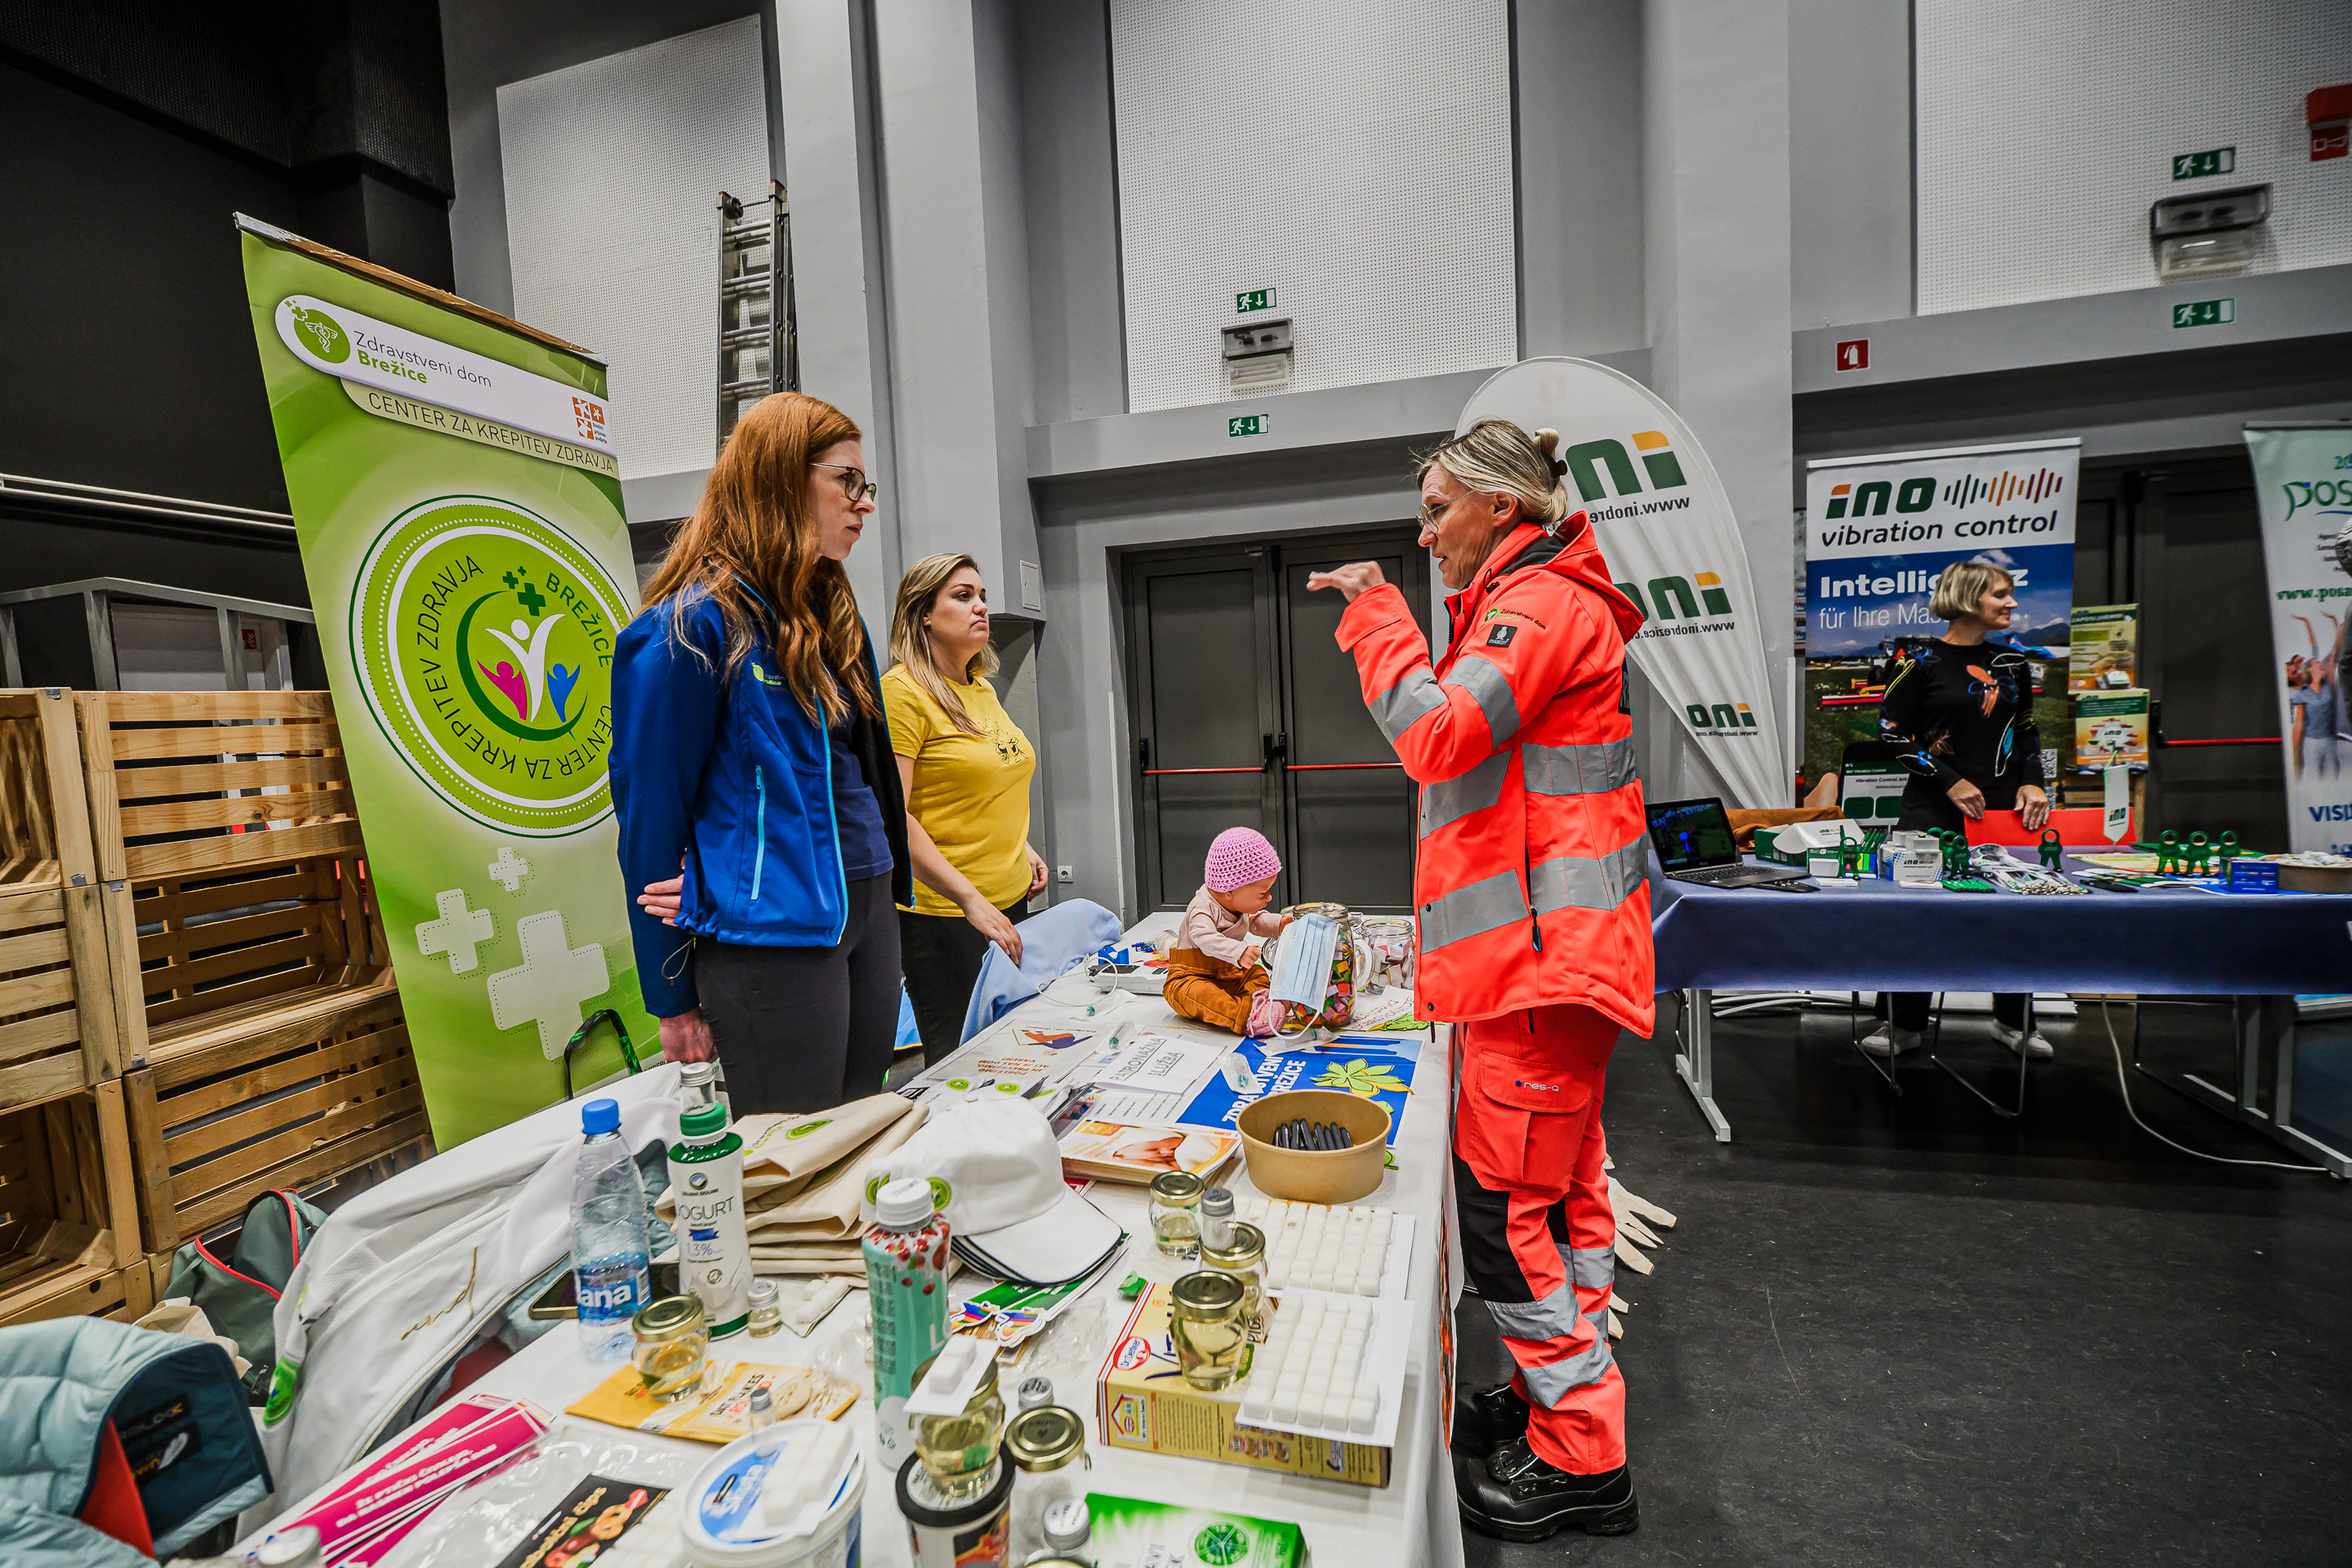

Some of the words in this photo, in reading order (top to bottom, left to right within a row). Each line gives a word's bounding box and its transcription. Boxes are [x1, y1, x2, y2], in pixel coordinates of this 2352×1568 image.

[354, 330, 453, 376] Zdravstveni
[457, 364, 492, 388] dom
[357, 350, 428, 385] Brežice
[368, 392, 445, 429] CENTER
[449, 414, 474, 436] ZA
[477, 422, 552, 457] KREPITEV
[555, 444, 614, 474] ZDRAVJA
[1825, 476, 1937, 520] ino
[1821, 520, 1944, 547] vibration
[1954, 510, 2059, 537] control
[416, 555, 484, 650] ZDRAVJA
[546, 572, 613, 668] BREŽICE
[1500, 608, 1534, 621] Zdravstveni
[1534, 619, 1547, 630] dom
[1819, 606, 1846, 630] für
[1853, 606, 1891, 628] Ihre
[418, 657, 516, 774] KREPITEV
[524, 756, 554, 780] ZA
